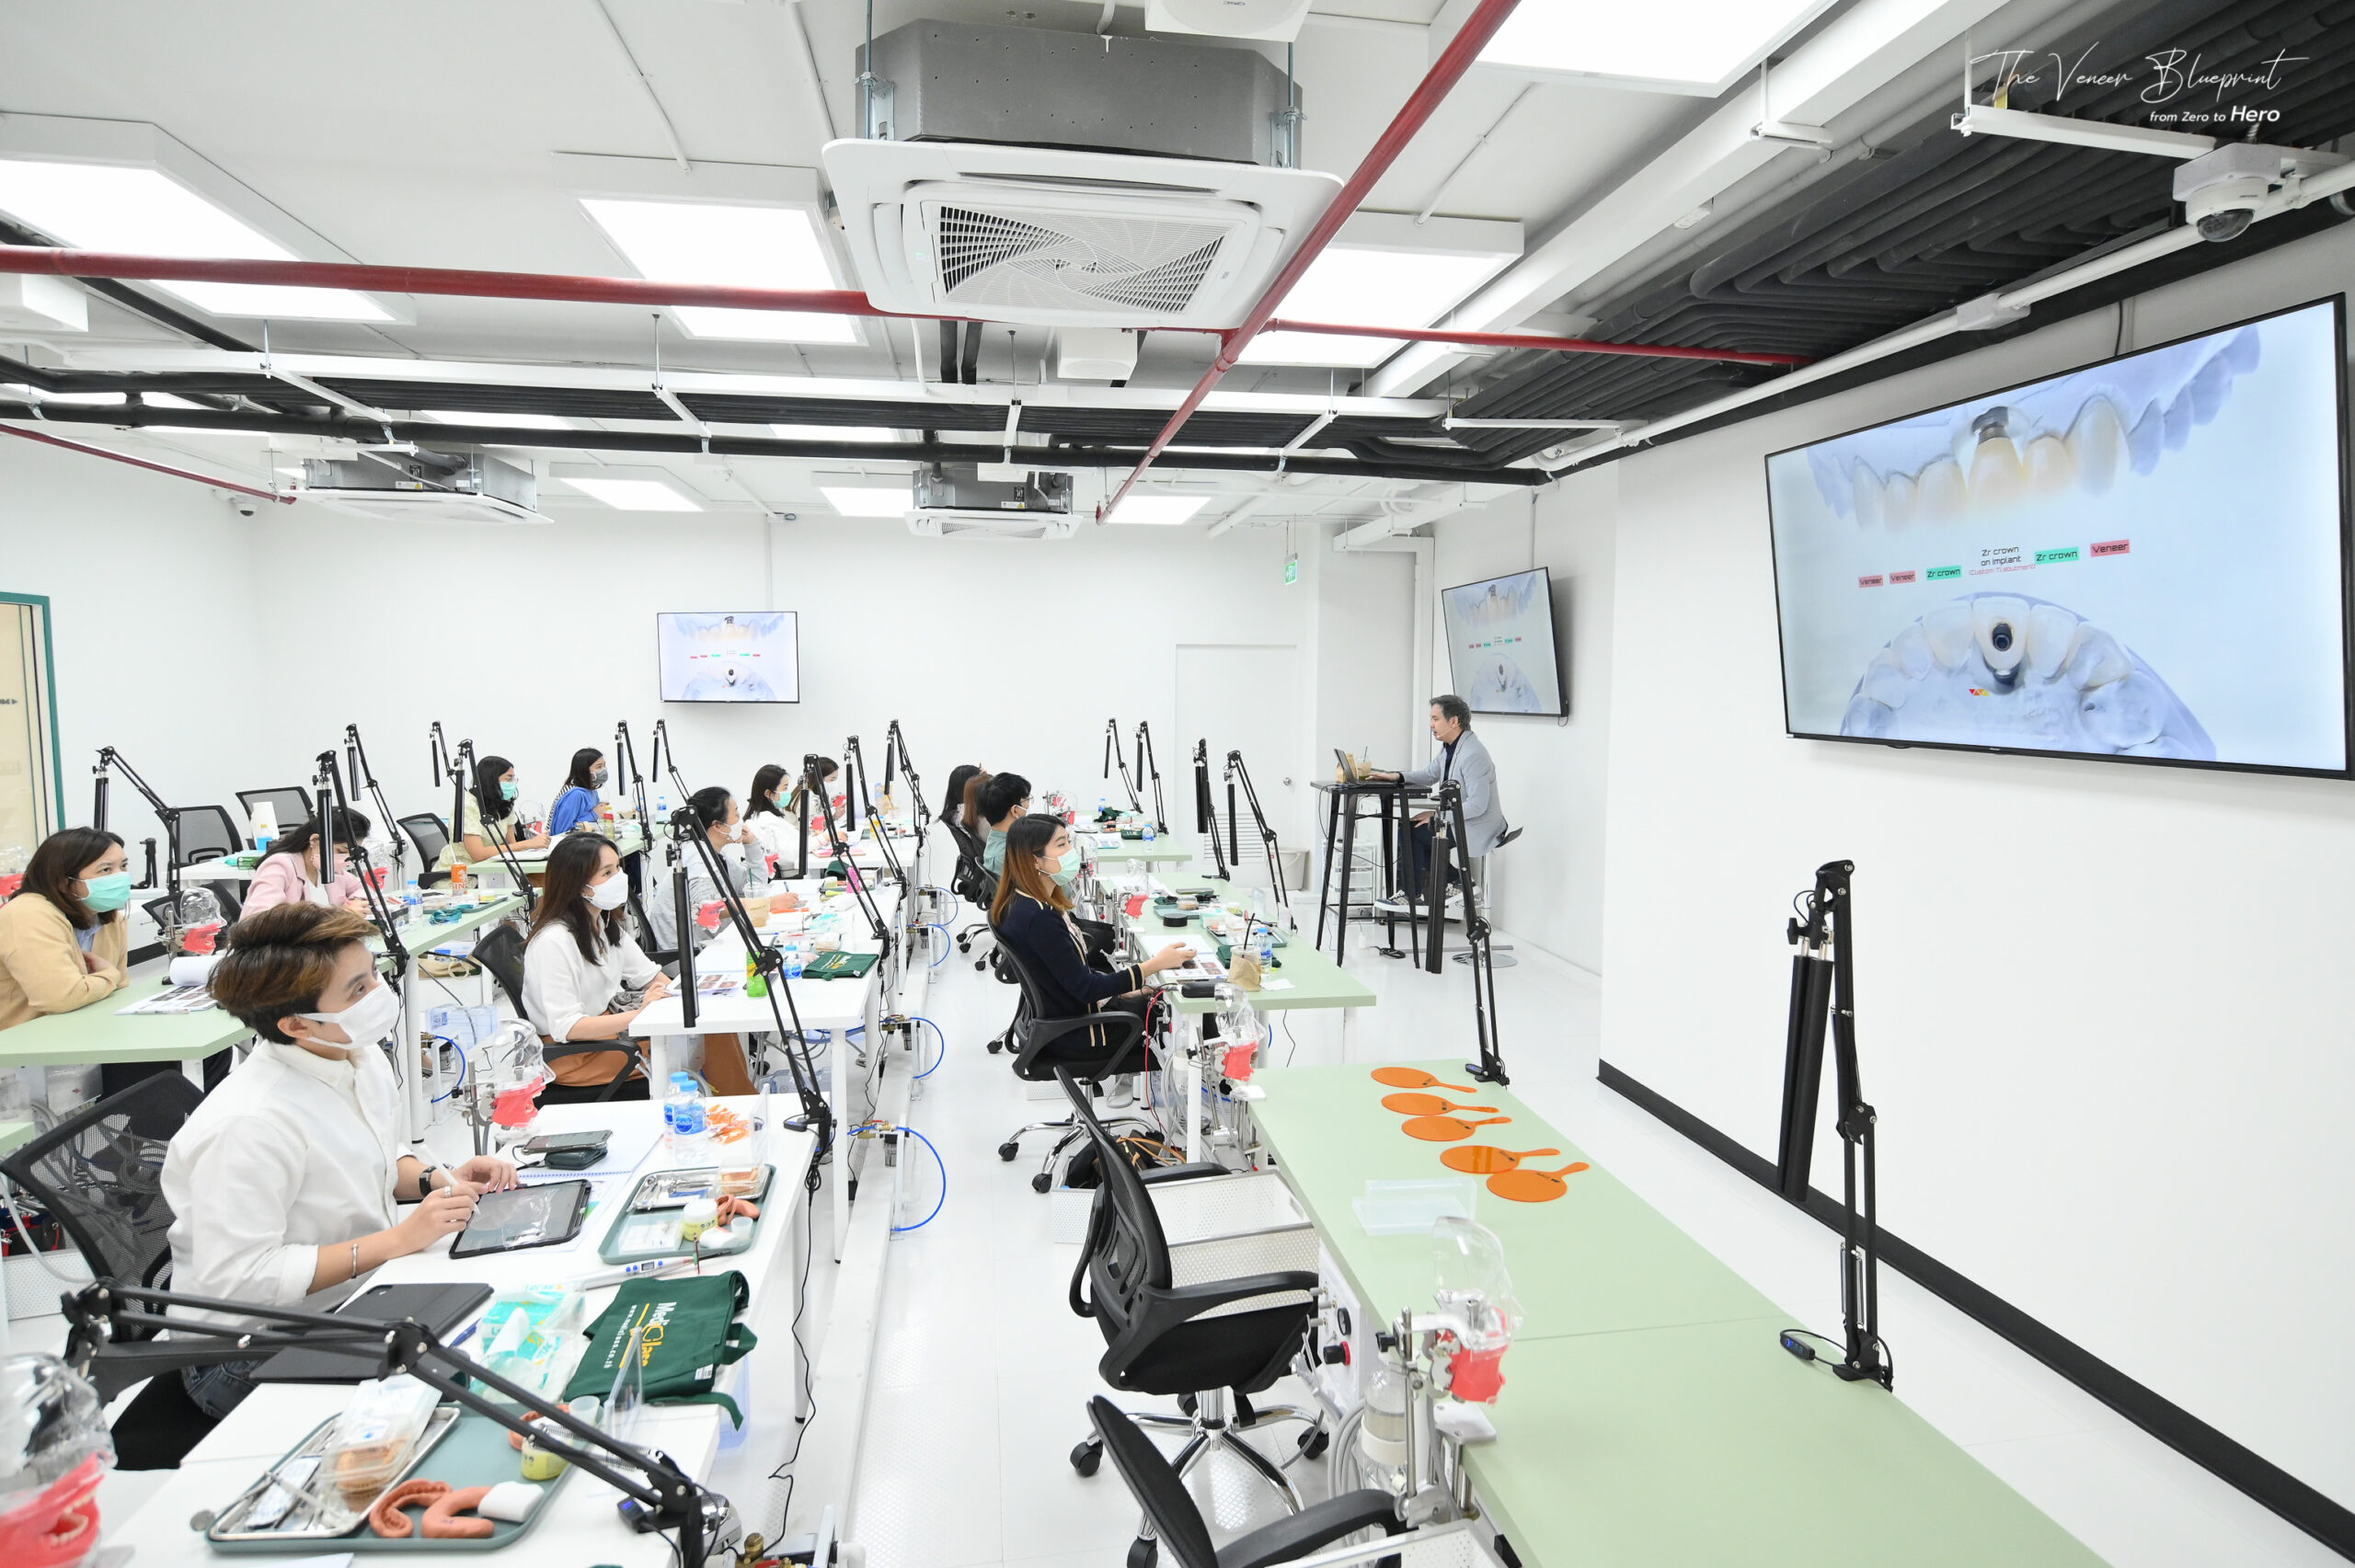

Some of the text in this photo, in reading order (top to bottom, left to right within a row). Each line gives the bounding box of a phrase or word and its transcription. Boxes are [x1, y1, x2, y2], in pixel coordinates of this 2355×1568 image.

[1993, 545, 2019, 555] crown
[2092, 543, 2129, 554] Veneer
[1992, 555, 2022, 567] implant
[2036, 550, 2078, 562] Zr crown
[1890, 573, 1914, 582] Veneer
[1927, 568, 1961, 578] Zr crown
